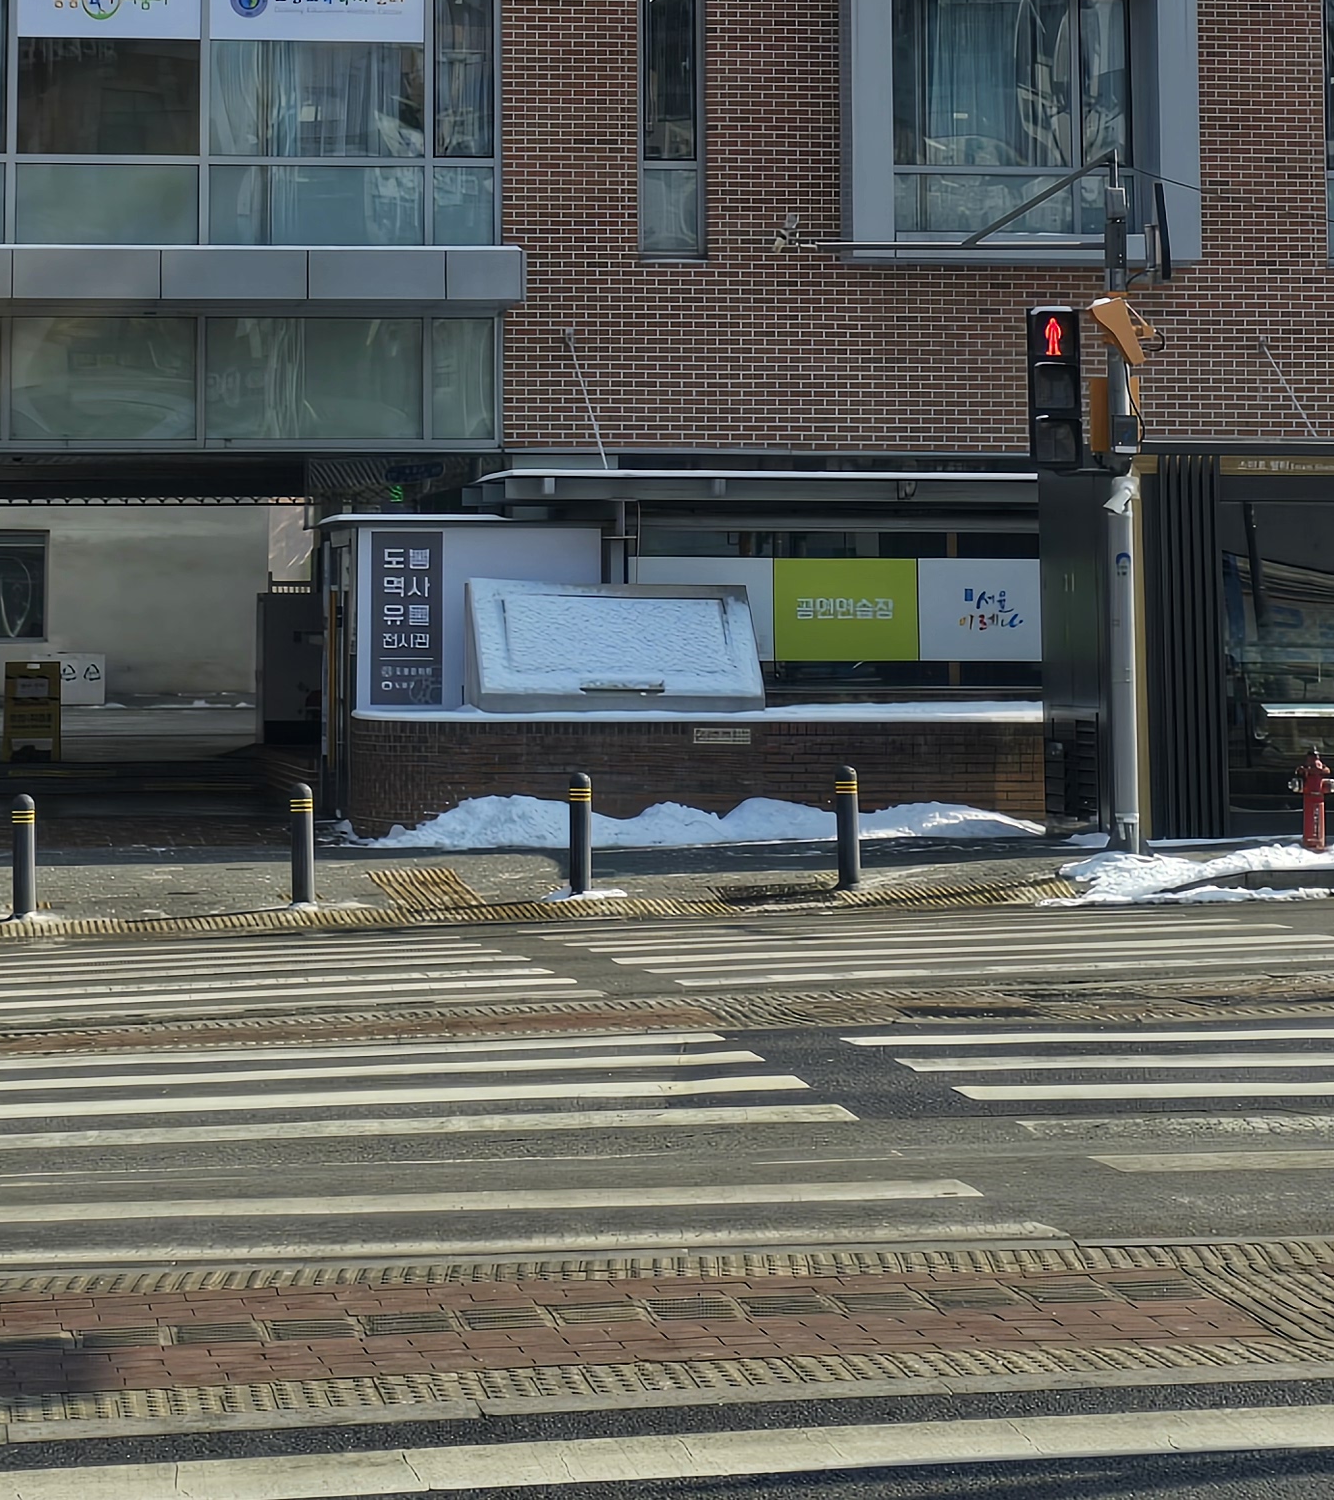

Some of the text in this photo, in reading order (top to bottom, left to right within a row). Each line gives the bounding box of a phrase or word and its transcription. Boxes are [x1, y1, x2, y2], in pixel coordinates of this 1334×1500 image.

[383, 576, 430, 597] 역사
[796, 597, 894, 620] 공연연습장
[976, 590, 1015, 613] 서울
[382, 633, 430, 648] 전시관
